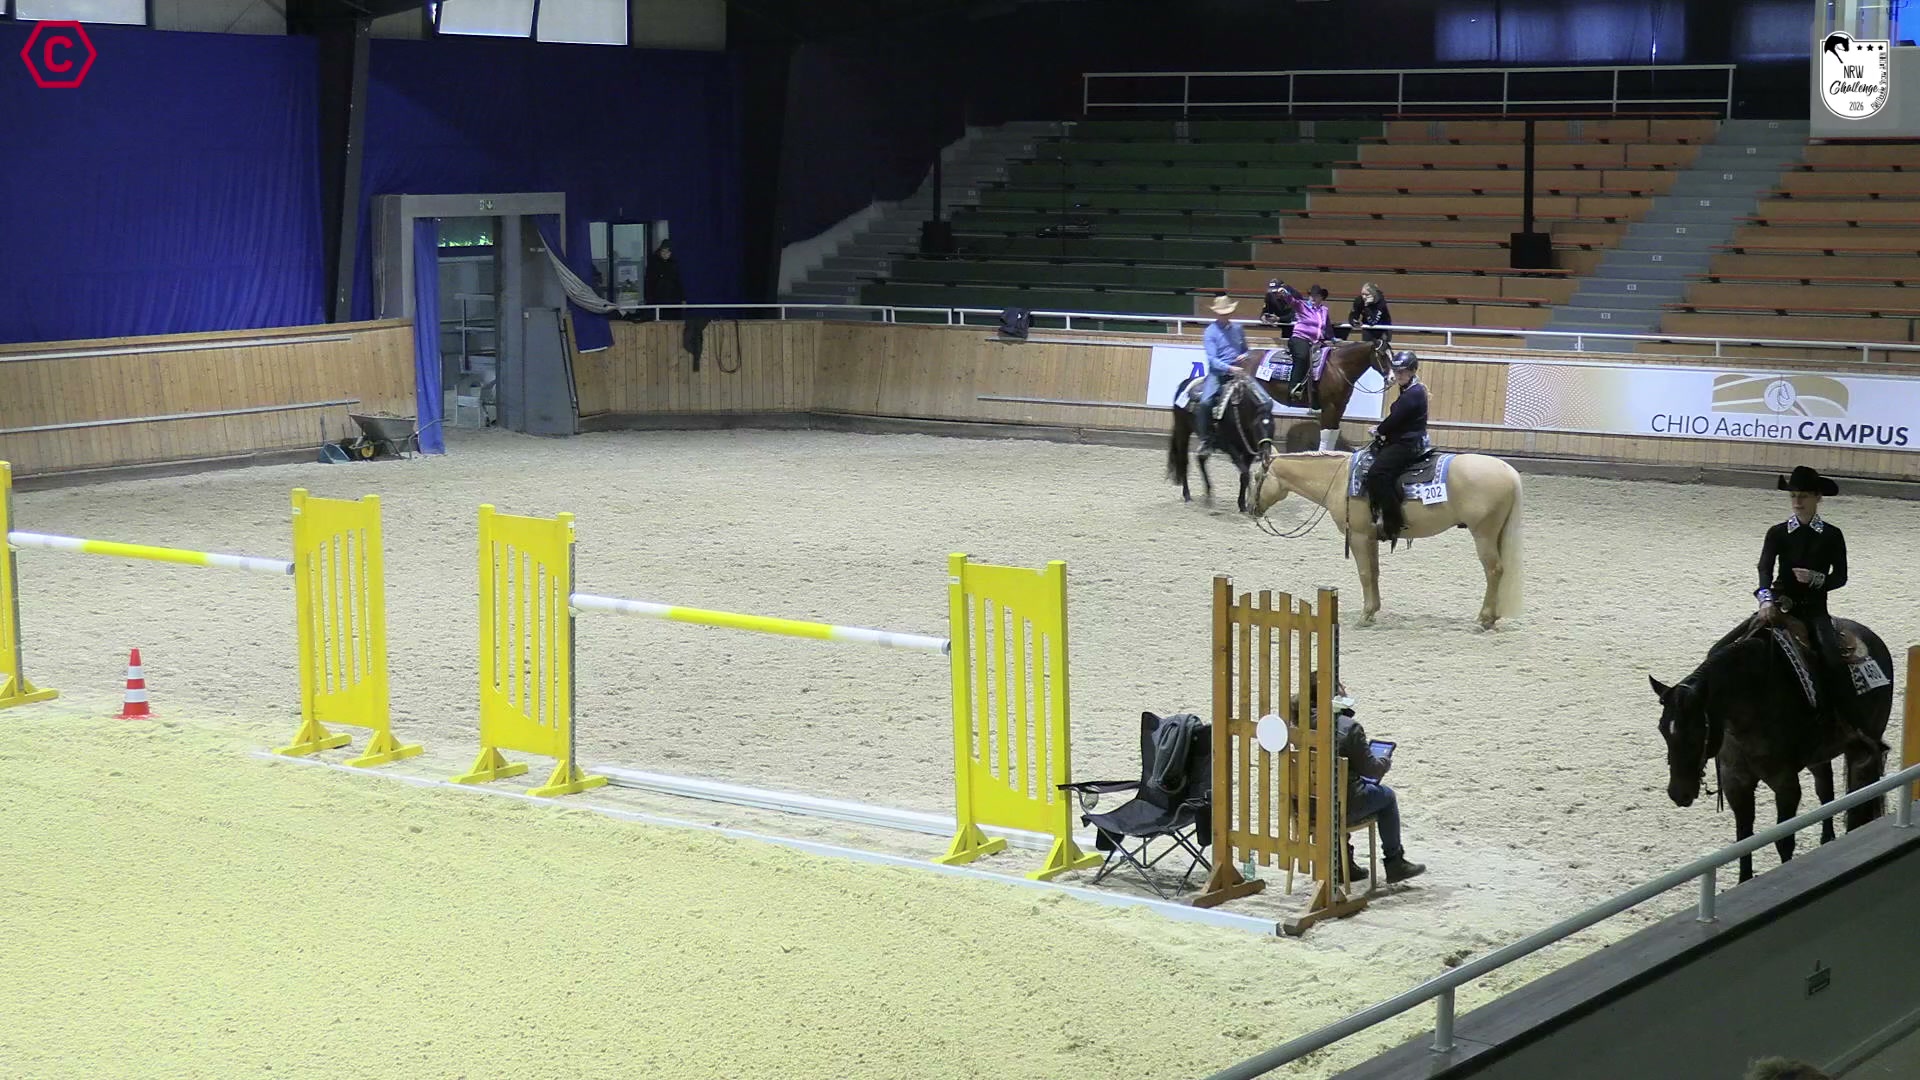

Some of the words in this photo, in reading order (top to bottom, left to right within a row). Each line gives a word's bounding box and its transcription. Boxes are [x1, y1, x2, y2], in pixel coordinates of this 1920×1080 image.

[1651, 414, 1709, 434] CHIO
[1714, 417, 1792, 439] Aachen
[1798, 421, 1909, 446] CAMPUS
[1425, 486, 1442, 499] 202
